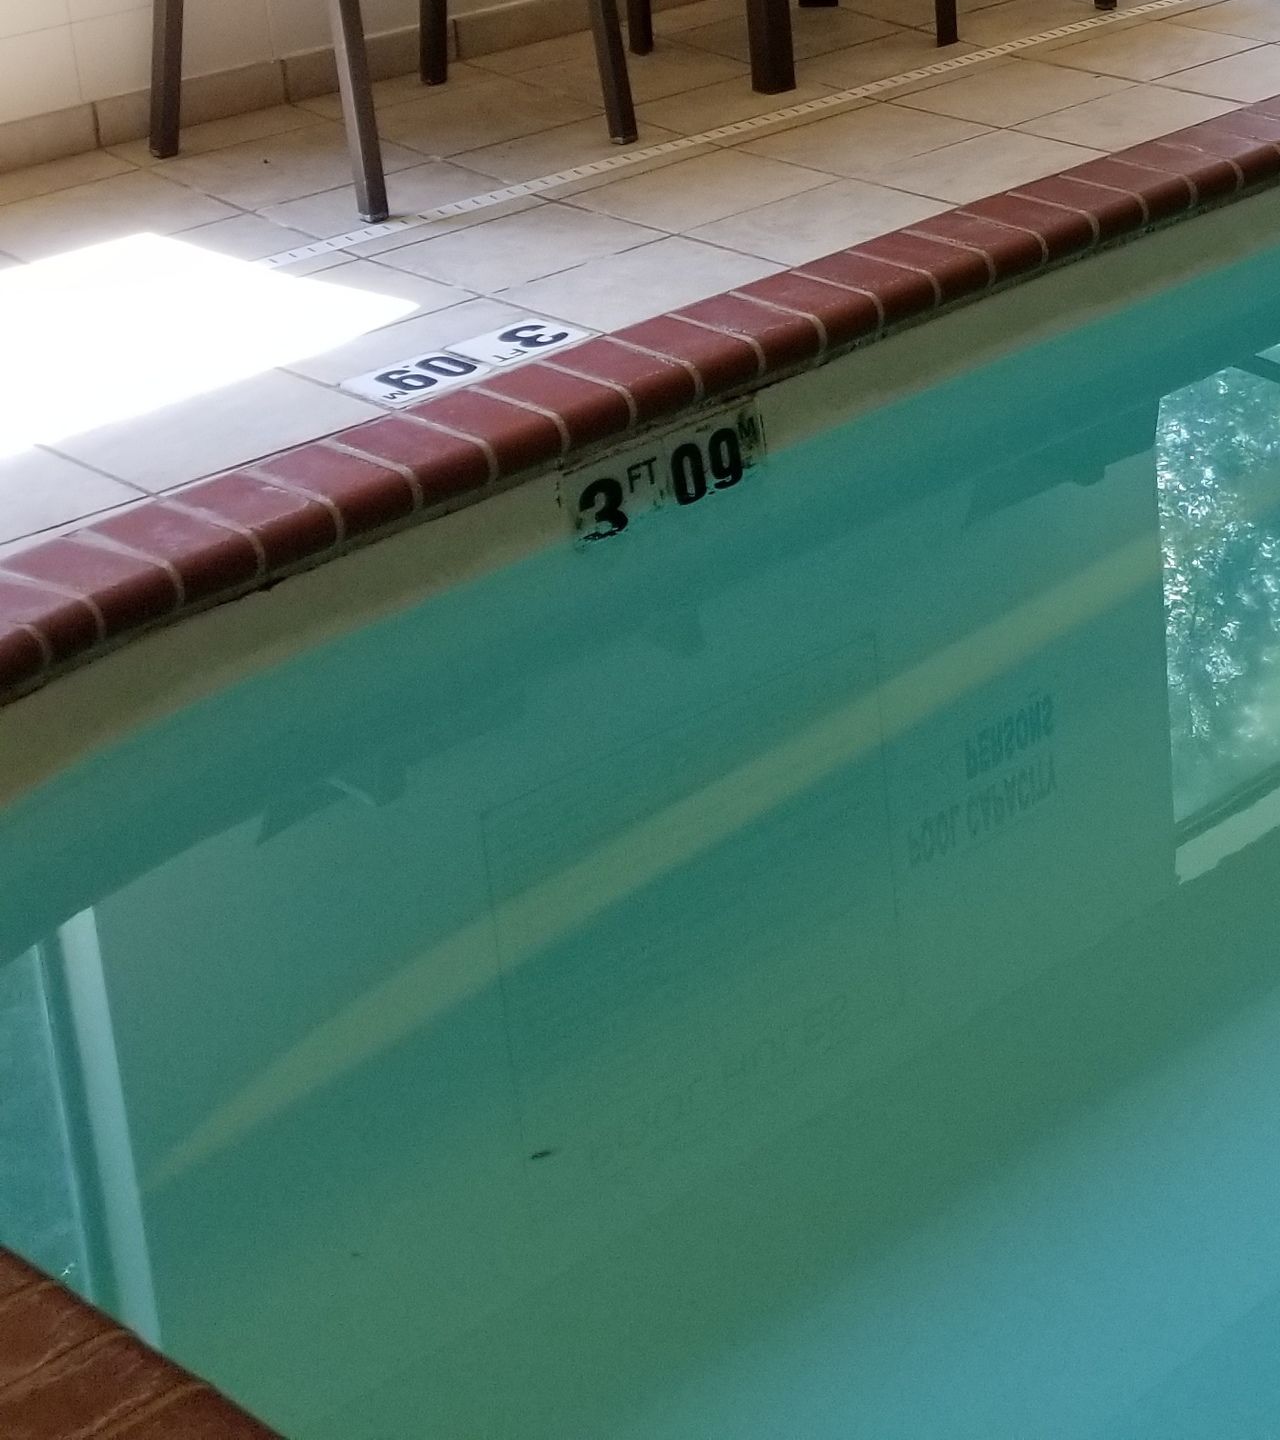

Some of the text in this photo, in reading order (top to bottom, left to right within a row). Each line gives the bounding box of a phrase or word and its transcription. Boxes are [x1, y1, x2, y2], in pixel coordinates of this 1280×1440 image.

[498, 324, 570, 348] 3
[579, 477, 629, 542] 3
[627, 455, 658, 494] FT
